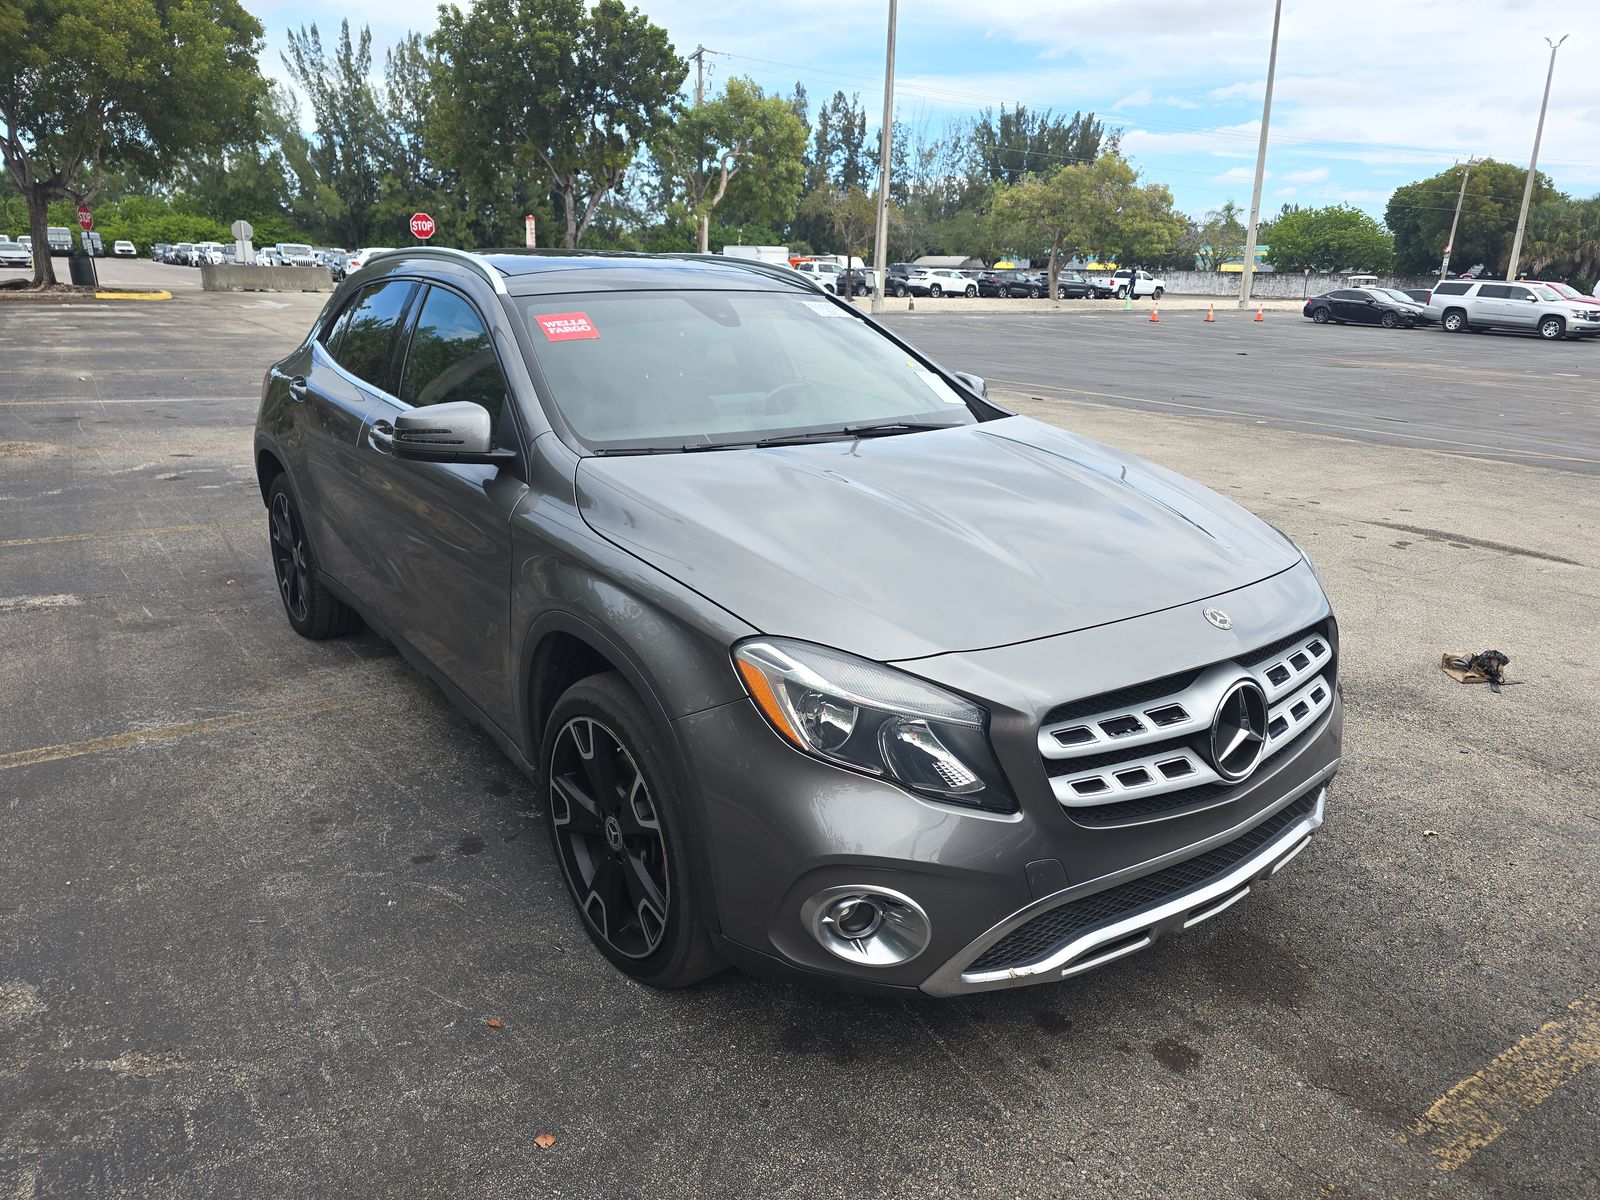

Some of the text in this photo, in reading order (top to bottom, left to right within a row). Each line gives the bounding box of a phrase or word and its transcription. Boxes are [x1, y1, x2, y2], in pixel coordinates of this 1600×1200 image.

[412, 221, 433, 231] STOP
[542, 319, 587, 327] WELLS
[547, 325, 591, 334] FARGO
